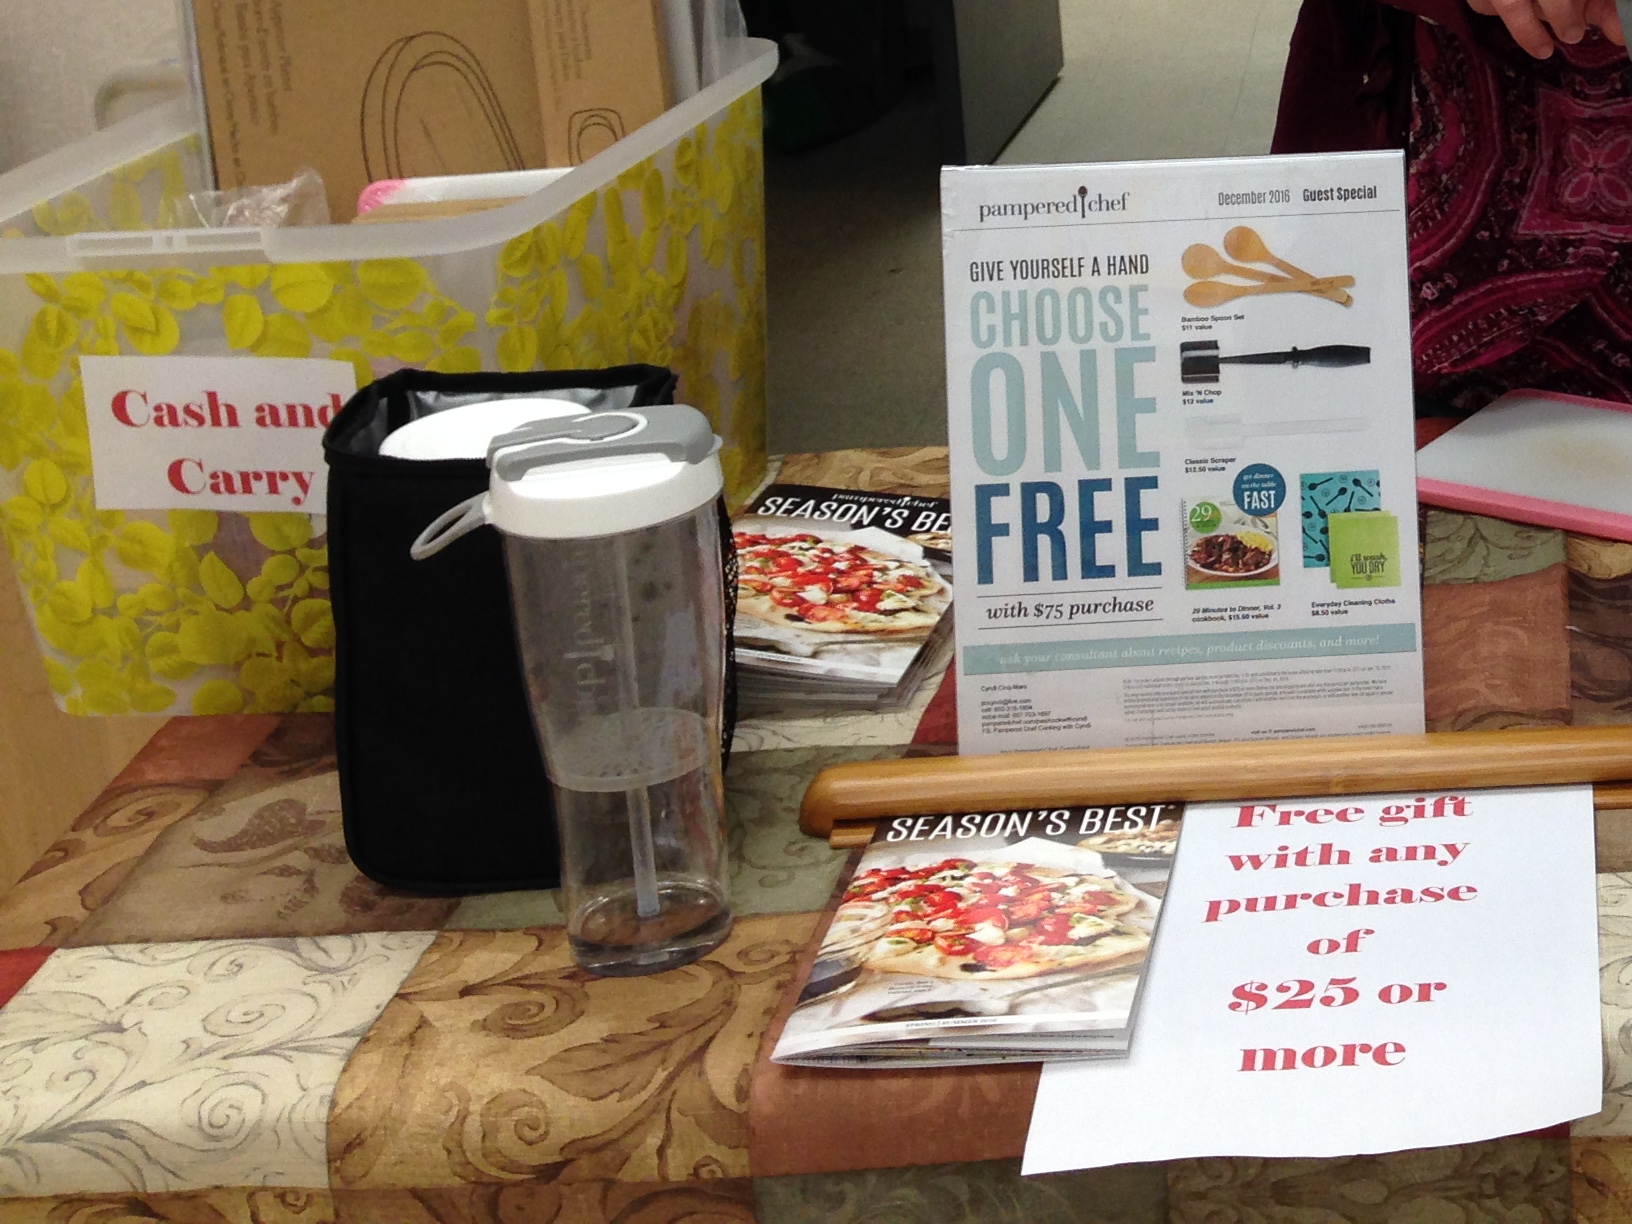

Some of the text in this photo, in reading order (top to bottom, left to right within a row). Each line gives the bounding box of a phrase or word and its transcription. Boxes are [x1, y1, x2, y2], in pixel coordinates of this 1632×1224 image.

[979, 185, 1377, 222] pampered chef December 2016 Guest Special
[970, 254, 1149, 282] GIVE YOURSELF A HAND
[970, 284, 1151, 349] CHOOSE
[109, 387, 343, 431] Cash and
[970, 346, 1161, 477] ONE
[166, 456, 314, 505] Carry
[757, 496, 909, 529] SEASON'S
[1191, 504, 1212, 522] 29
[1243, 490, 1276, 510] FAST
[974, 475, 1163, 586] FREE
[986, 596, 1154, 620] with $75 purchase
[1023, 652, 1052, 666] your
[1121, 646, 1156, 658] about
[1206, 640, 1253, 655] product
[1319, 635, 1342, 647] and
[1345, 634, 1380, 646] more!
[885, 804, 1168, 845] SEASON'S BEST
[1231, 793, 1475, 831] Free gift
[1225, 836, 1474, 873] with any
[1202, 878, 1479, 924] purchase
[1305, 927, 1376, 958] of
[1226, 977, 1448, 1017] $25 or
[1237, 1038, 1408, 1074] more
